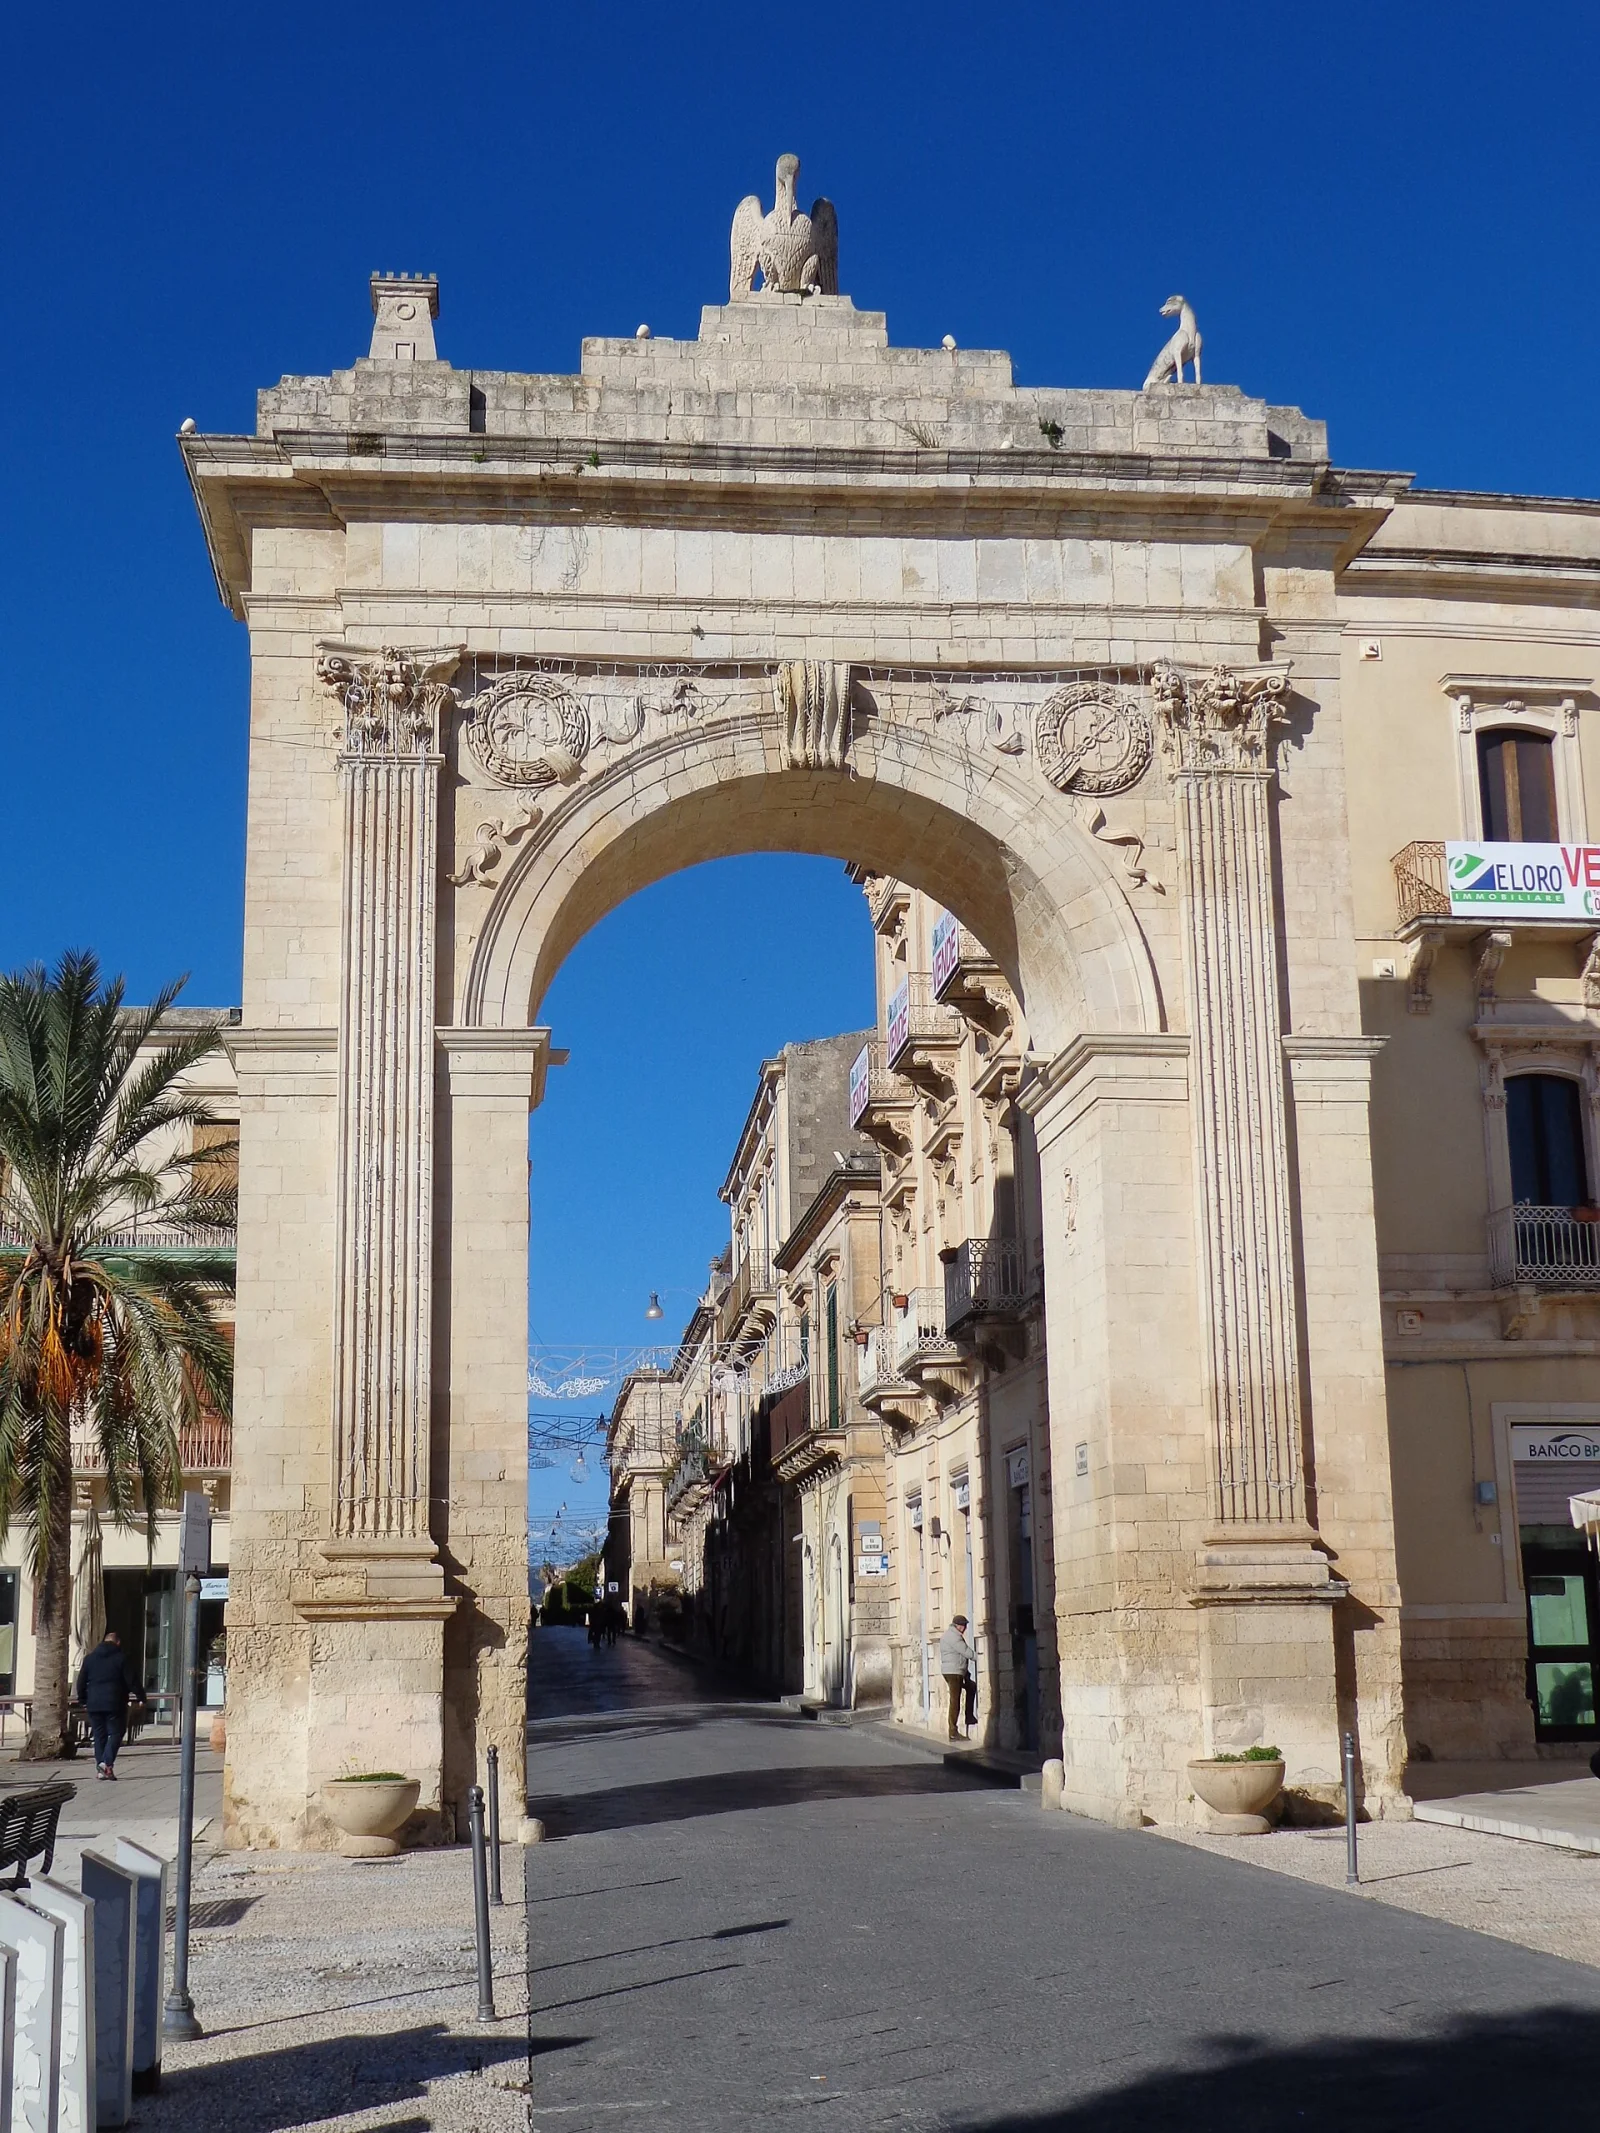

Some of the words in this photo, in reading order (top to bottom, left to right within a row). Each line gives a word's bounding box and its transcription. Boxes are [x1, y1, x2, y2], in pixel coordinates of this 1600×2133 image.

[1496, 863, 1562, 893] ELORO
[1455, 892, 1562, 903] IMMOBILIARE
[1528, 1444, 1581, 1458] BANCO
